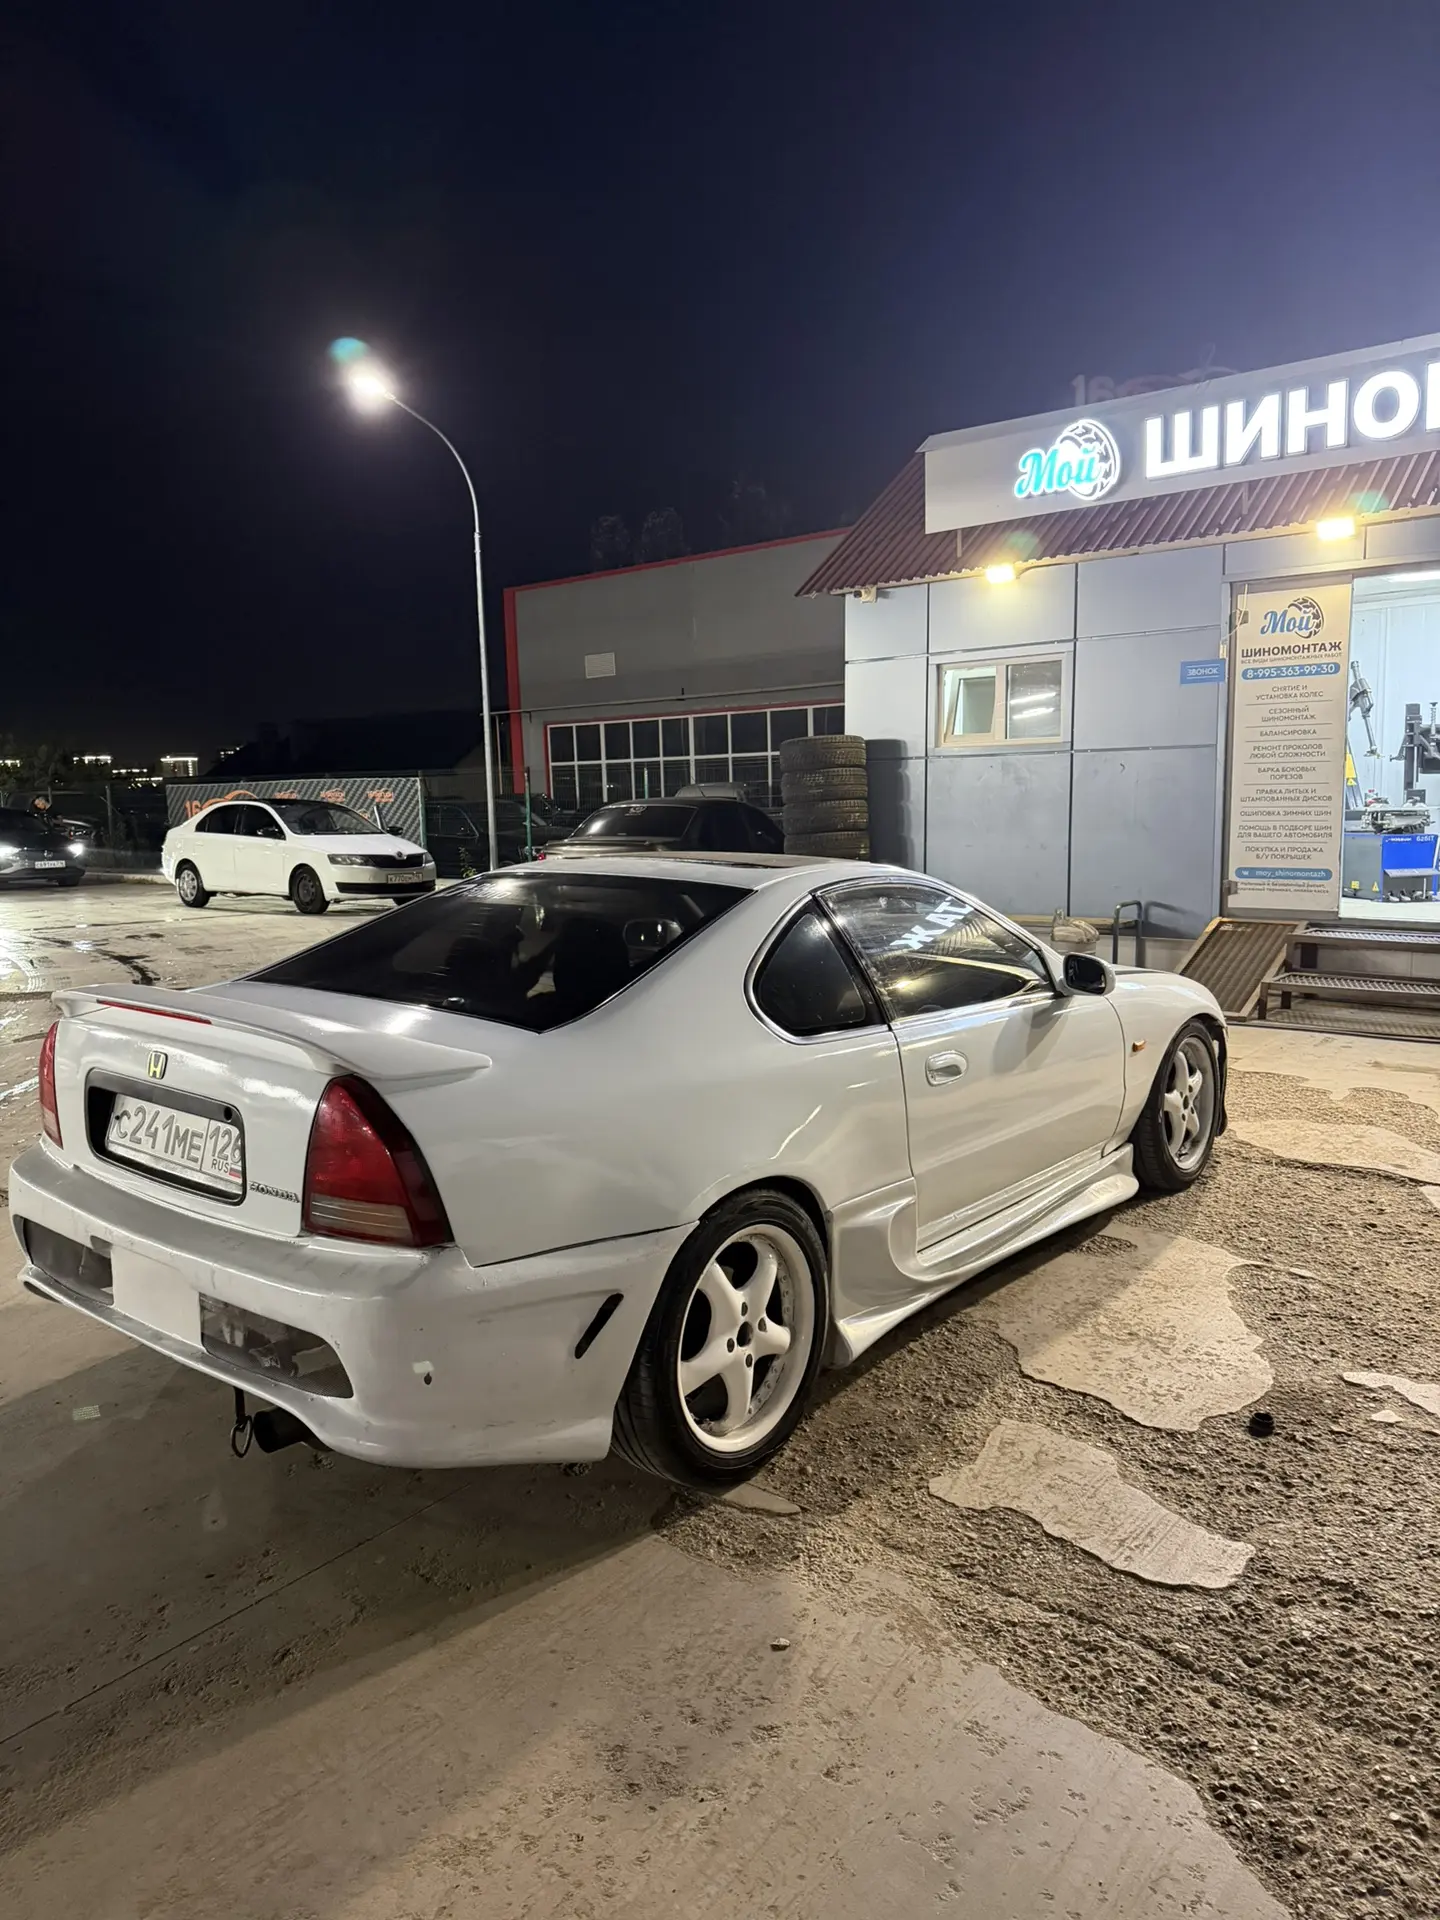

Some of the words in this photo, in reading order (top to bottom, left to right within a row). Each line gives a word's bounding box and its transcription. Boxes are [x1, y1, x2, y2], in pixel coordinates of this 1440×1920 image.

[1014, 444, 1100, 498] Мой
[1260, 608, 1316, 635] Мой
[1241, 641, 1343, 658] ШИНОМОНТАЖ
[1187, 667, 1219, 676] ЗВОНОК
[1246, 663, 1336, 679] 8-995-363-99-30
[1256, 692, 1298, 700] УСТАНОВКА
[1269, 705, 1310, 715] СЕЗОННЫЙ
[1261, 714, 1316, 722] ШИНОМОНТАЖ
[1260, 729, 1317, 737] БАЛАНСИРОВКА
[1253, 744, 1282, 752] РЕМОНТ
[1282, 743, 1323, 751] ПРОКОЛОВ
[1249, 750, 1276, 759] ЛЮБОЙ
[1255, 869, 1326, 878] moy_shinomontazh
[210, 1158, 230, 1174] RUS
